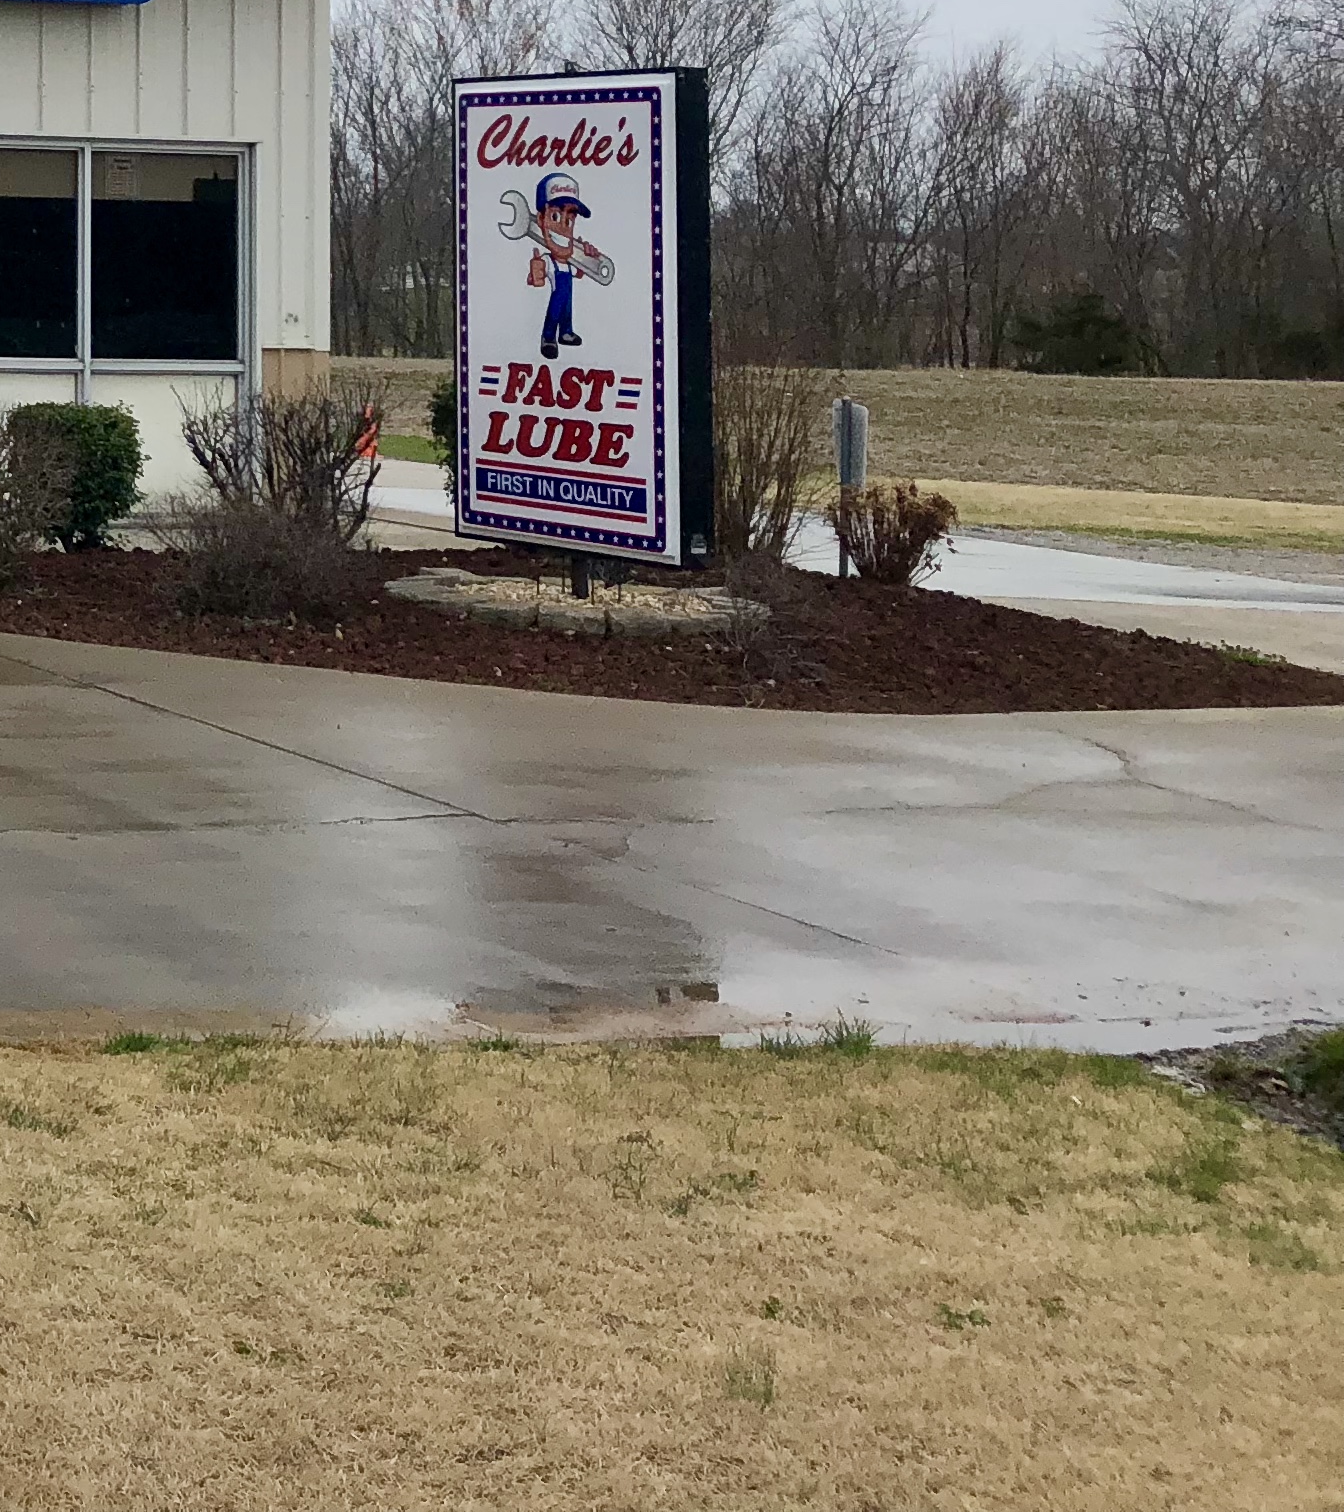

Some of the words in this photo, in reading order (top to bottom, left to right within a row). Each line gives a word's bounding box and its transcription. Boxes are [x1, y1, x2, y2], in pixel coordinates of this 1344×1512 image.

[476, 112, 640, 170] Charlie's
[501, 361, 615, 412] FAST
[480, 410, 634, 468] LUBE
[487, 471, 534, 495] FIRST
[537, 478, 555, 498] IN
[559, 481, 634, 509] QUALITY
